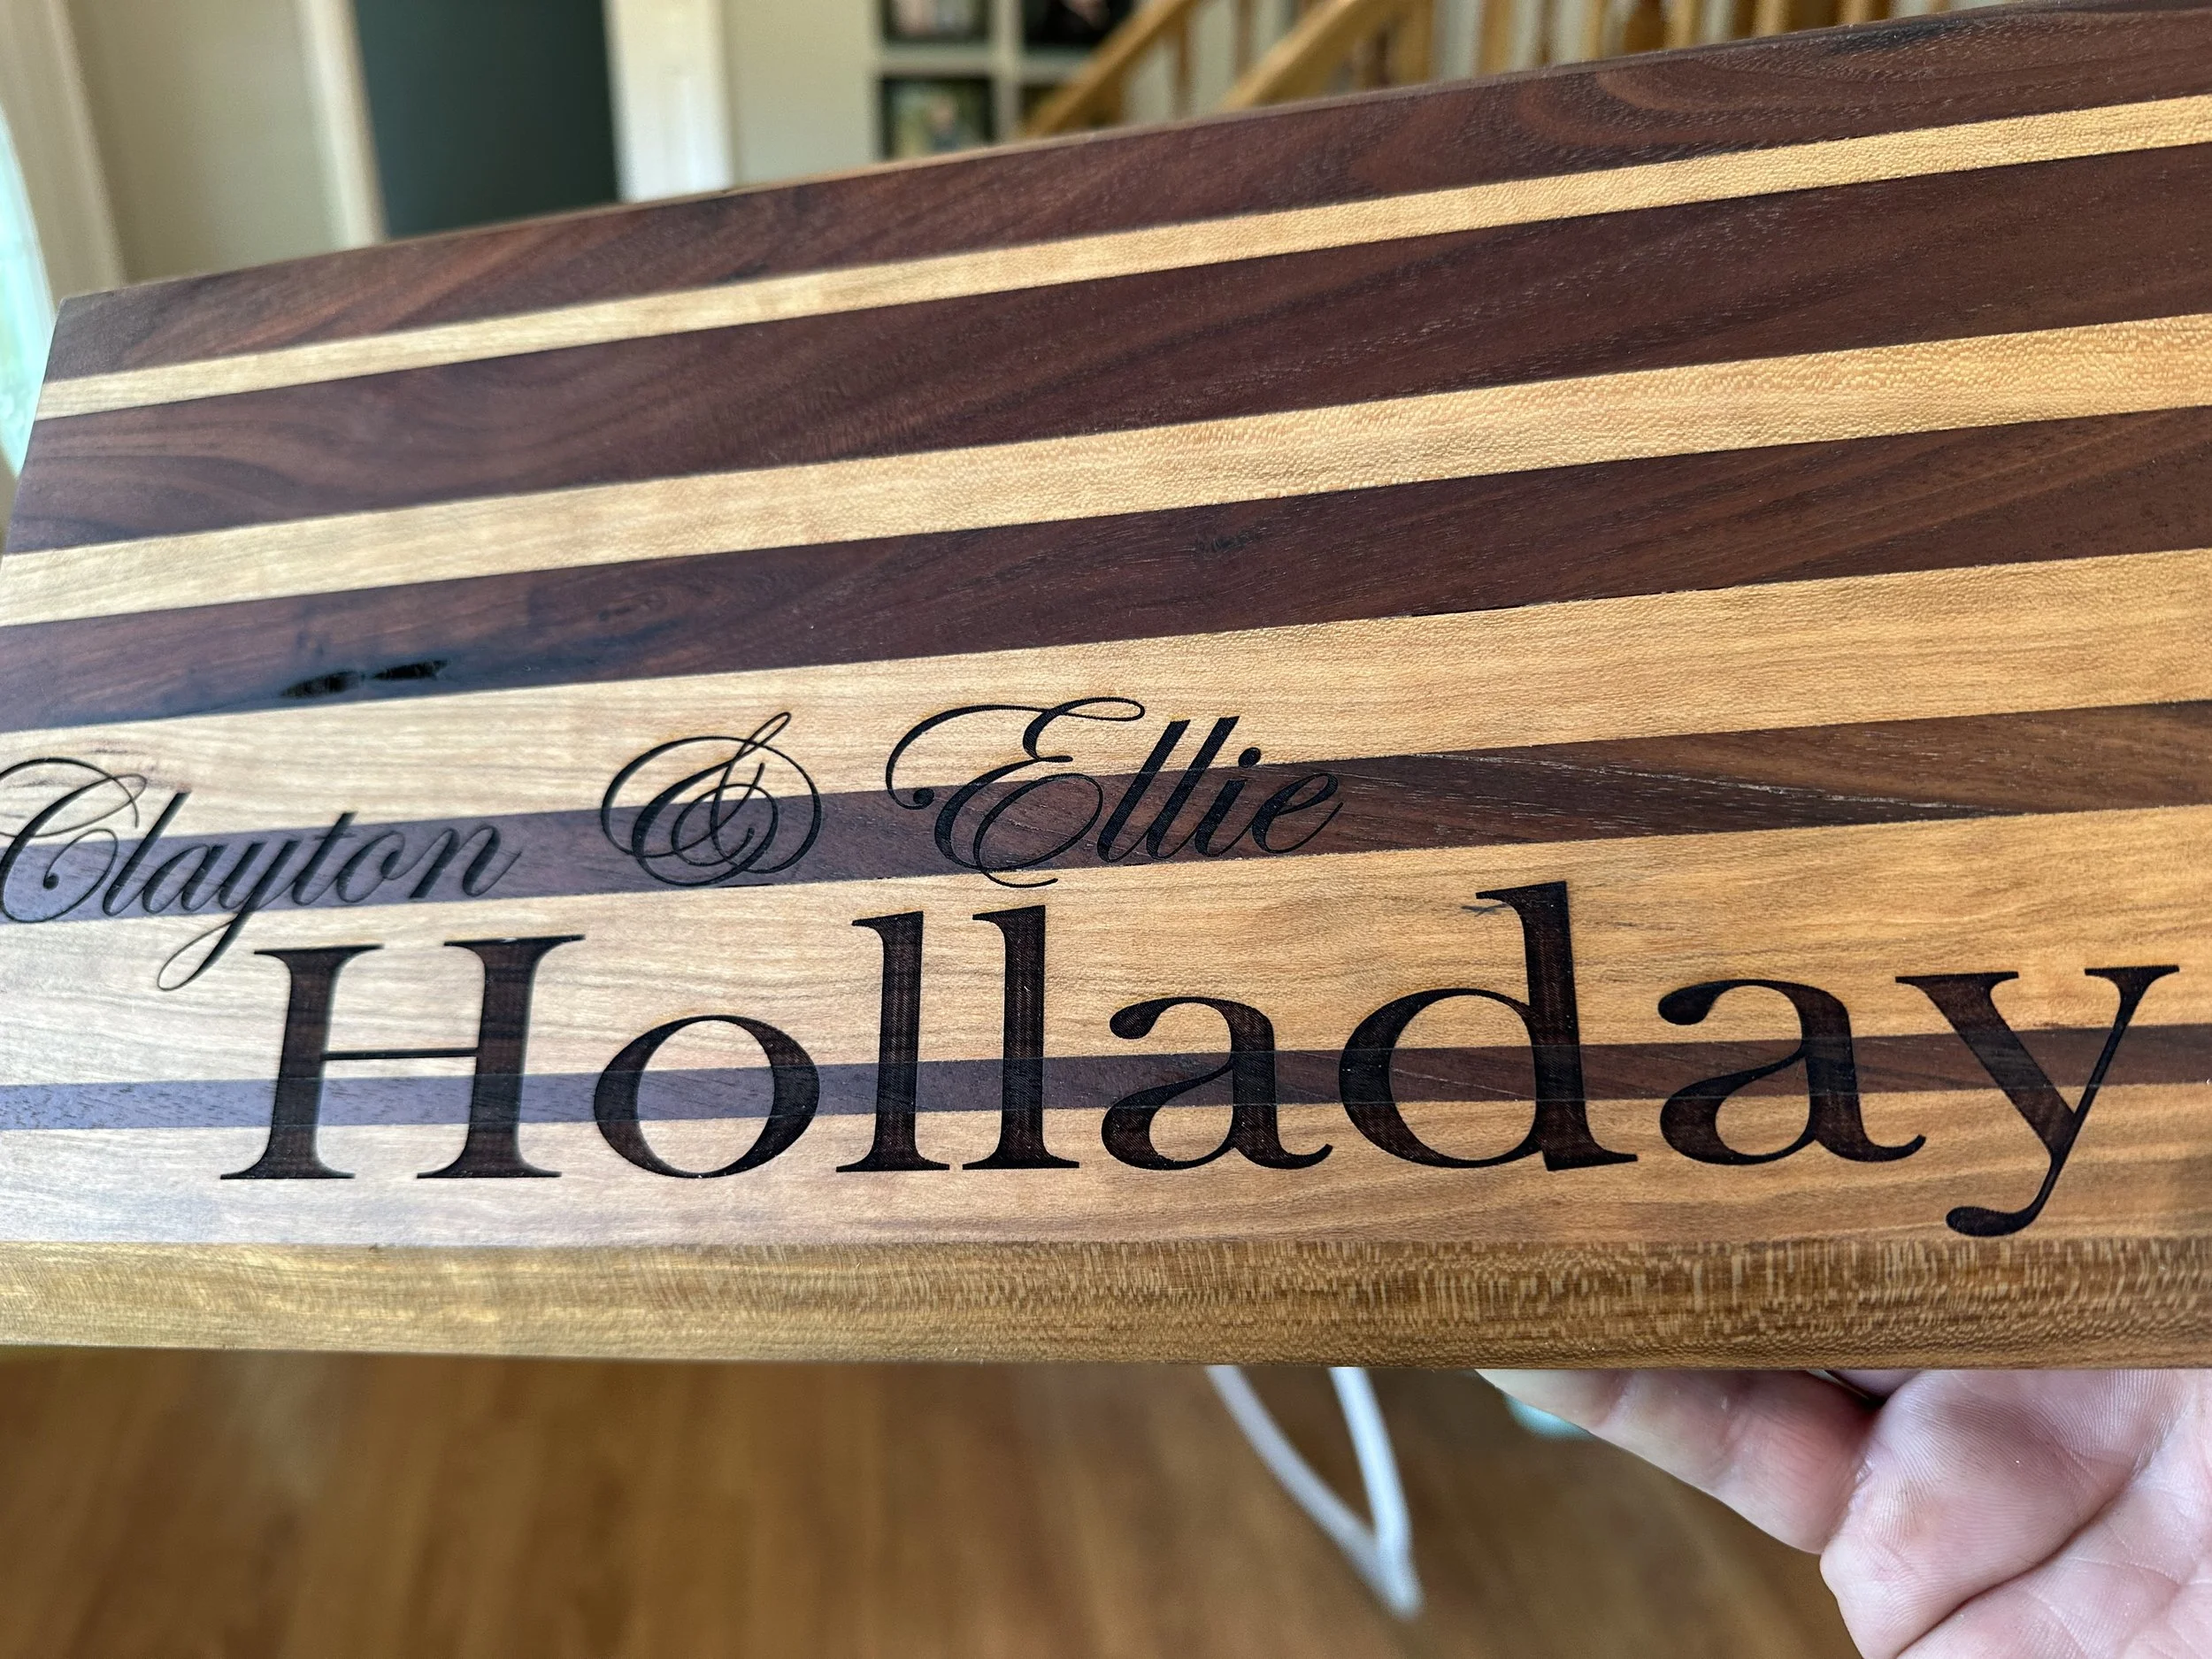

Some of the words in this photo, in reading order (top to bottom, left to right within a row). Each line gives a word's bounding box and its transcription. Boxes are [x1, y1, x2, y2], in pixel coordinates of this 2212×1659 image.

[0, 757, 523, 991] Clayton
[598, 710, 821, 887] &
[886, 696, 1343, 888] Ellie
[219, 880, 2180, 1237] Holladay
